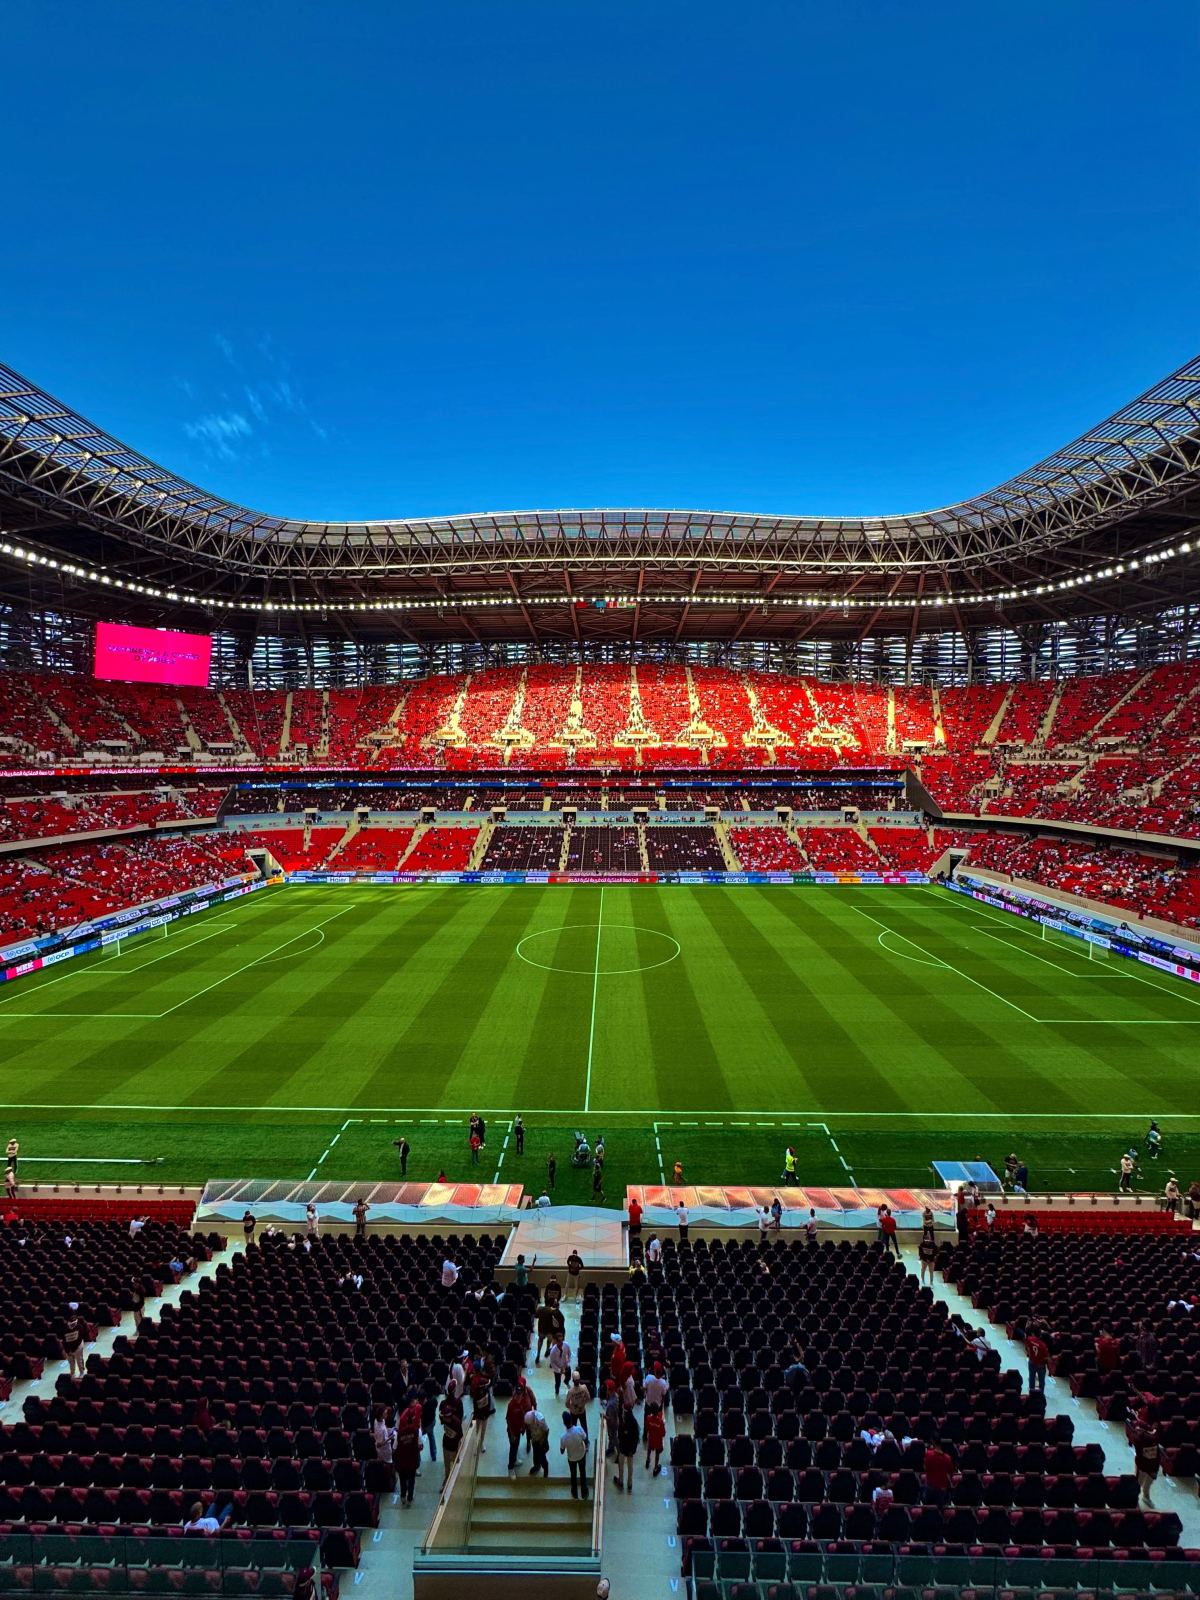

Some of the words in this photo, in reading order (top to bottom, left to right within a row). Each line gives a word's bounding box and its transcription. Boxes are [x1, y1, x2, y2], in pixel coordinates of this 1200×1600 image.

[1094, 937, 1107, 945] OCP
[16, 946, 31, 955] OCP
[56, 951, 70, 960] OCP
[664, 1499, 671, 1509] T
[372, 1531, 384, 1543] U
[667, 1536, 676, 1548] U
[354, 1572, 365, 1585] V
[670, 1579, 679, 1592] V
